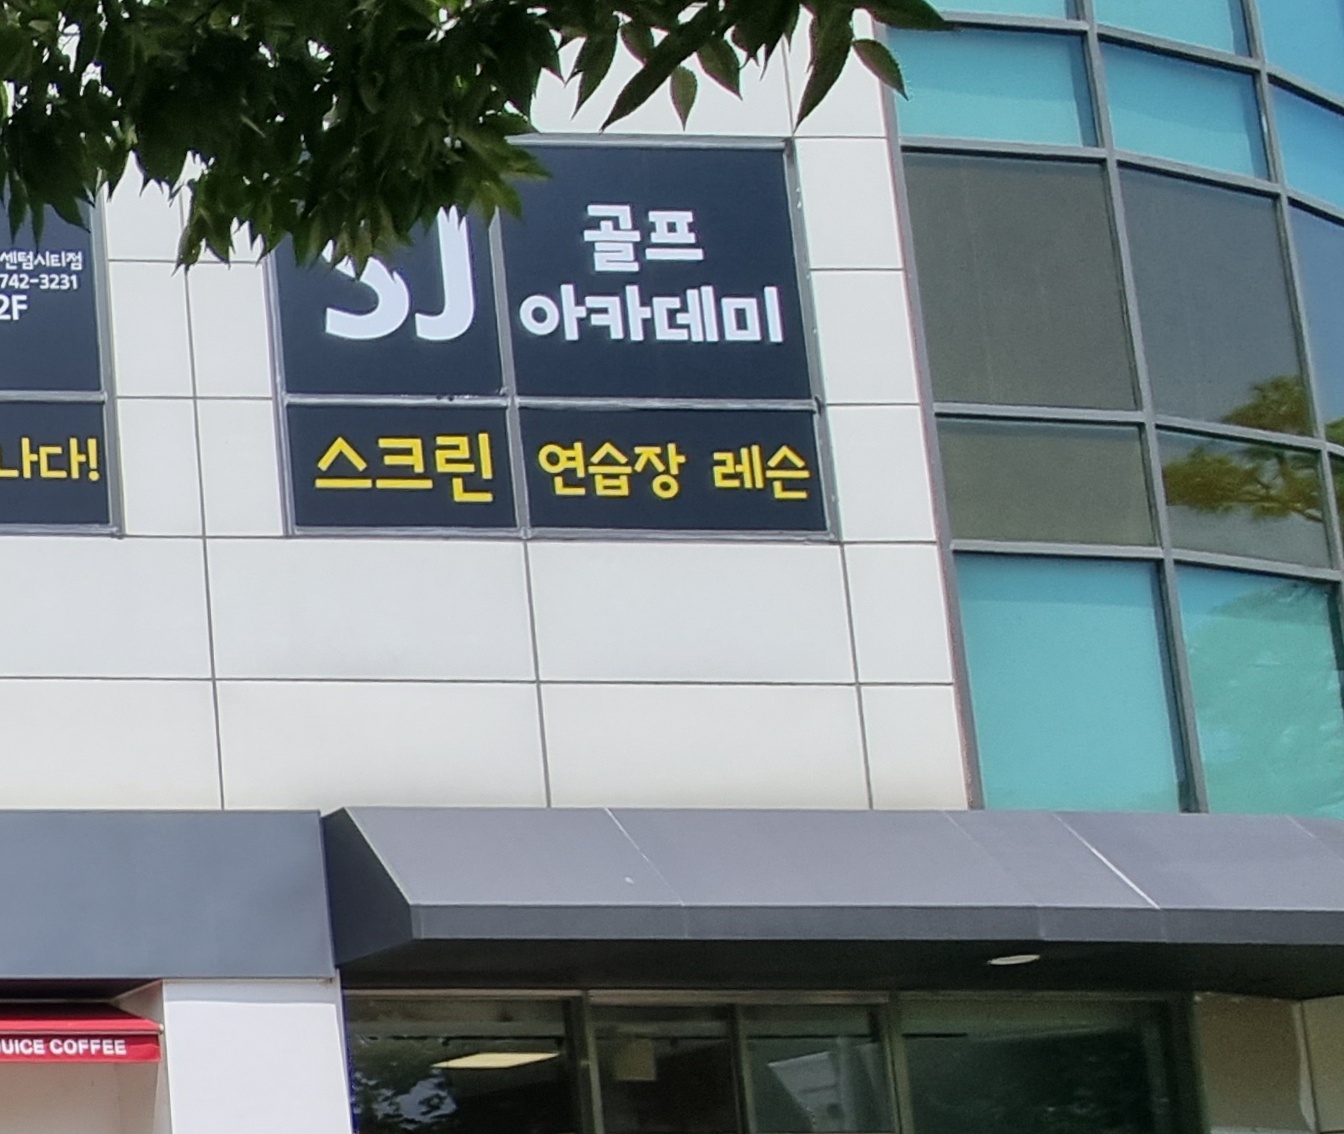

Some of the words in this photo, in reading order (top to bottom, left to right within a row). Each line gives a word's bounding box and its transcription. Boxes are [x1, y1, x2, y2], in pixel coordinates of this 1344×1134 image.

[0, 249, 84, 273] 센텀시티점
[583, 204, 704, 273] 골프
[520, 283, 785, 343] 아카데미
[314, 432, 494, 503] 스크린
[537, 441, 685, 499] 연습장
[712, 445, 810, 500] 레슨
[49, 1038, 127, 1056] COFFEE
